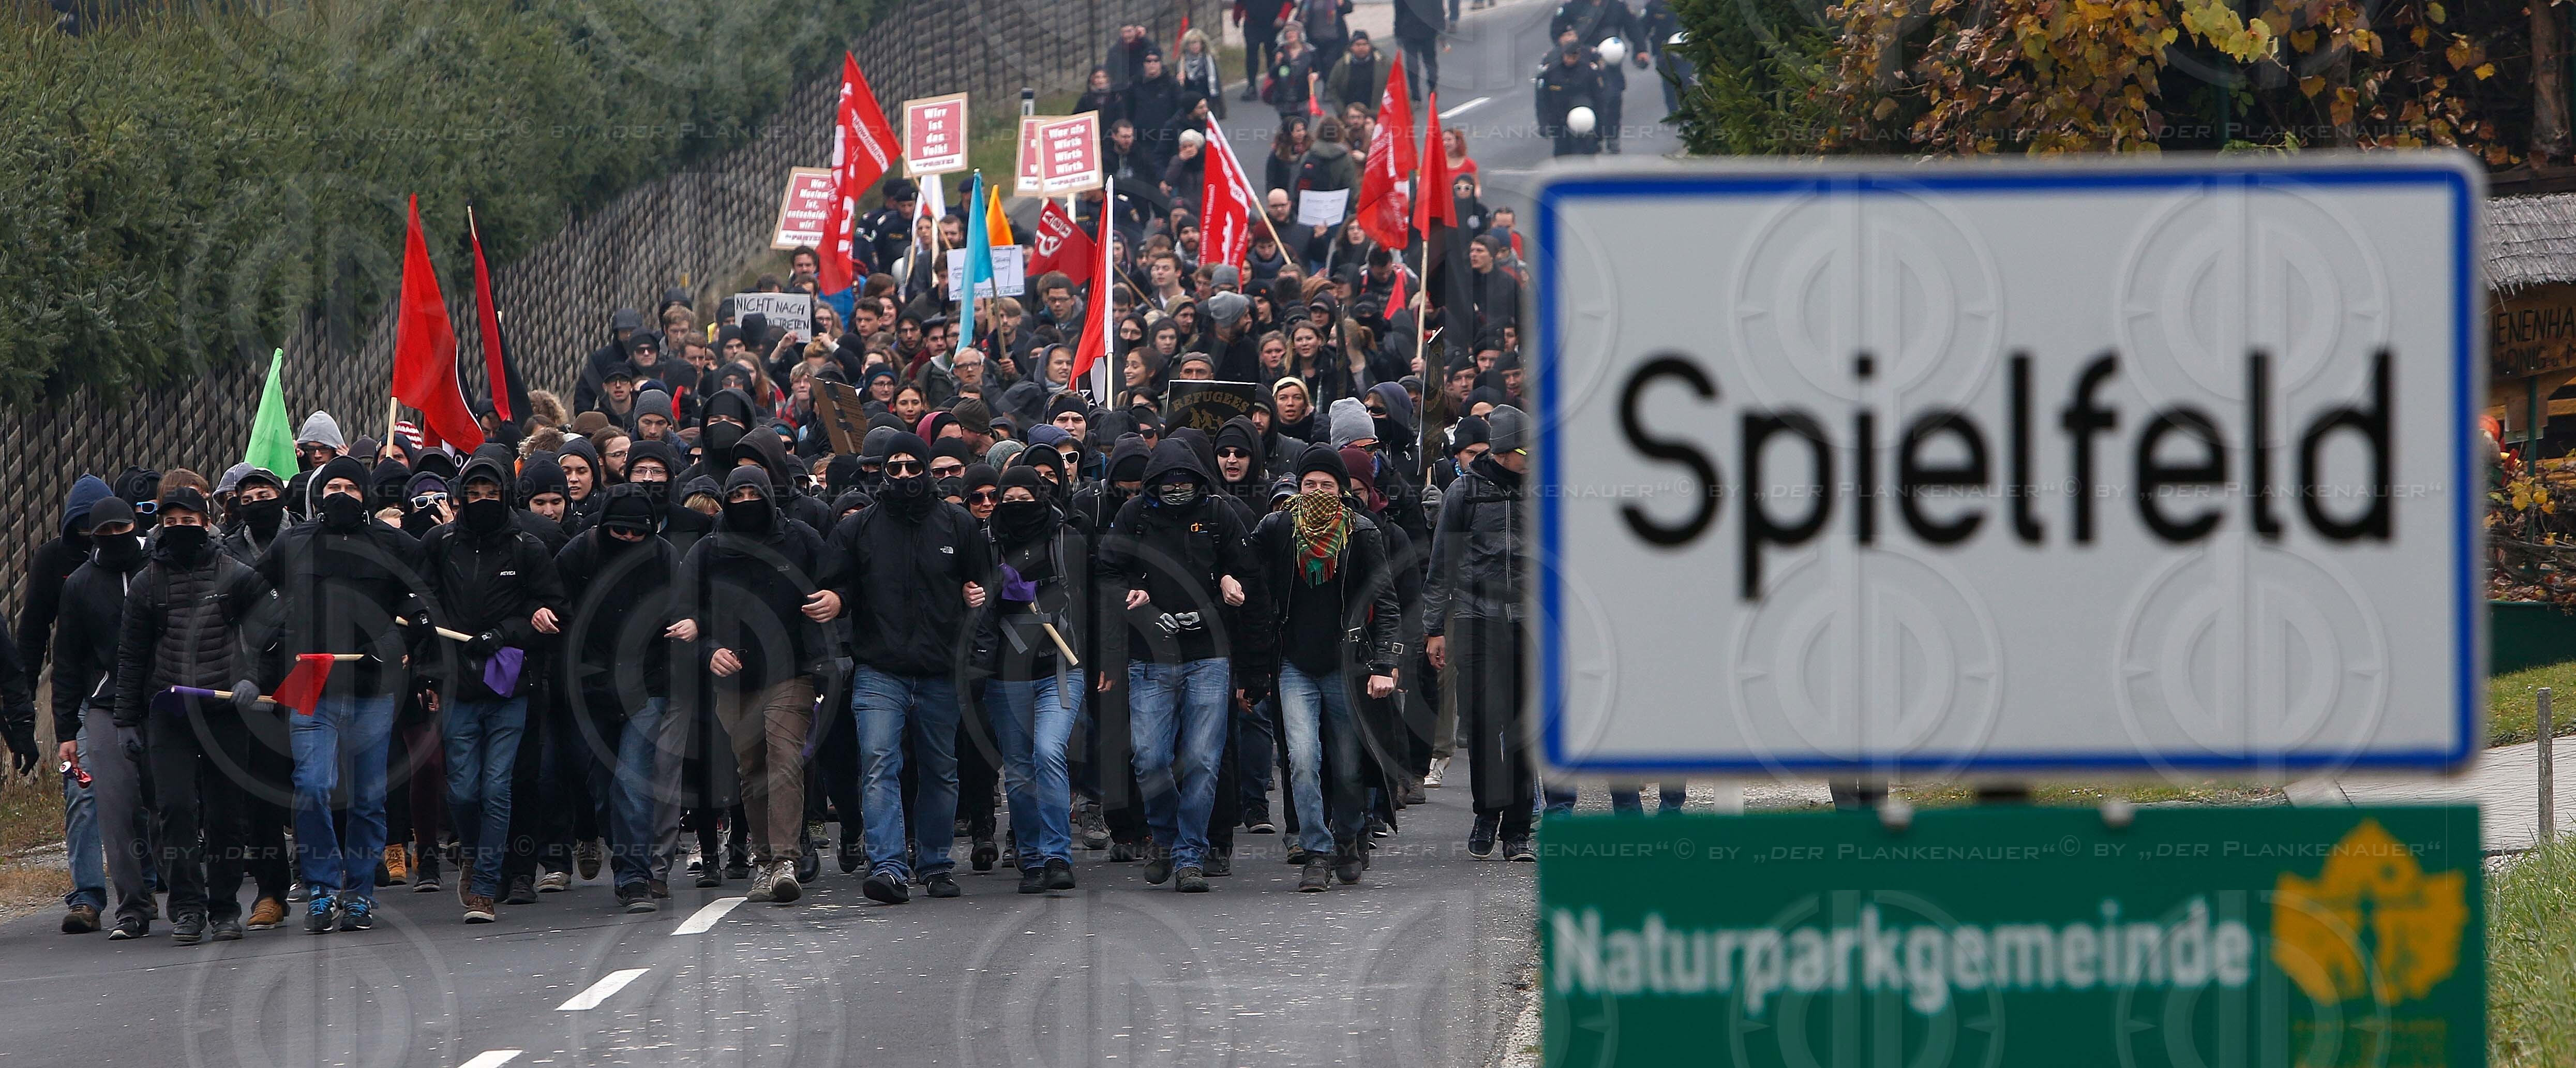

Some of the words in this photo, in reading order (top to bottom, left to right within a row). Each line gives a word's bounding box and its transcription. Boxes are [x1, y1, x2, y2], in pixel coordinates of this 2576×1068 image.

[928, 120, 943, 131] ist
[926, 132, 945, 144] das
[736, 298, 774, 312] NICHT
[775, 301, 805, 315] NACH
[1171, 391, 1250, 412] REFUGEES
[1616, 347, 2396, 604] Spielfeld
[1553, 901, 2252, 1014] Naturparkgemeinde
